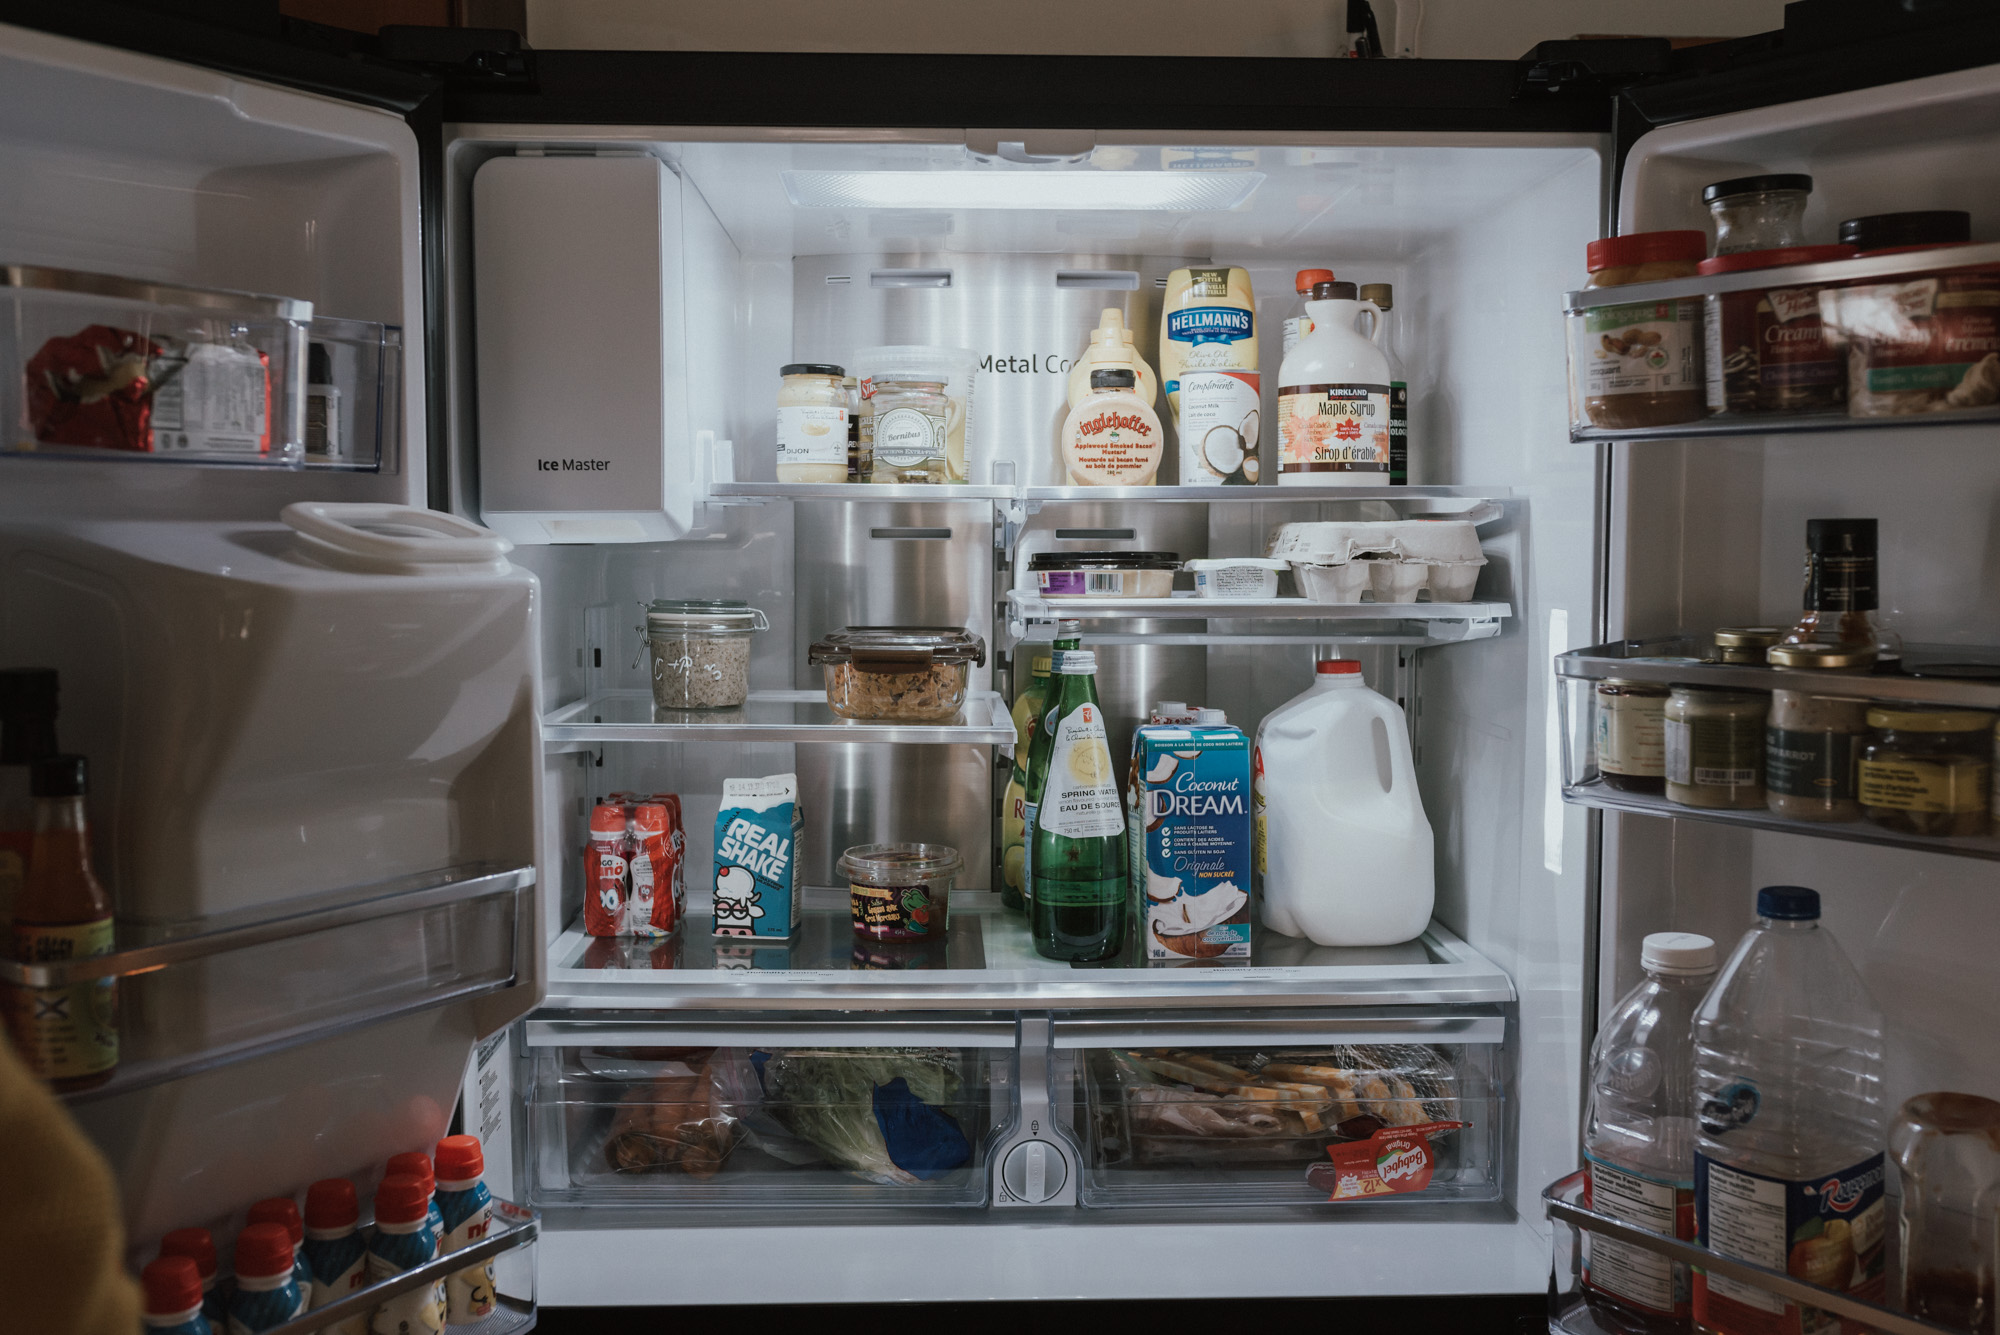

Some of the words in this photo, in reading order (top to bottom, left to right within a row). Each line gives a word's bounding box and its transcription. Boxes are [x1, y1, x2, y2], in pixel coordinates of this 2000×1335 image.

[1172, 311, 1248, 331] HELLMANN'S
[1214, 350, 1229, 358] Oil
[977, 353, 1038, 373] Metal
[1188, 379, 1234, 393] Compliments
[1329, 388, 1367, 396] KIRKLAND
[1318, 401, 1347, 417] Maple
[1350, 402, 1376, 417] Syrup
[1080, 411, 1152, 437] inglehoffer
[1315, 446, 1341, 461] Sirop
[1342, 445, 1376, 461] d'érable
[538, 459, 559, 471] Ice
[562, 459, 611, 471] Master
[1175, 771, 1240, 793] Coconut
[1061, 790, 1096, 799] SPRING
[1153, 789, 1243, 816] DREAM
[1060, 805, 1078, 813] EAU
[1095, 801, 1120, 809] SOURCE
[721, 811, 741, 833] VANILLA
[726, 817, 790, 863] REAL
[717, 836, 786, 882] SHAKE
[1173, 855, 1225, 877] Originale
[1213, 870, 1235, 878] SUCRÉE
[1385, 1140, 1411, 1152] Original
[1383, 1150, 1423, 1178] Babybel
[1363, 1179, 1382, 1194] x12
